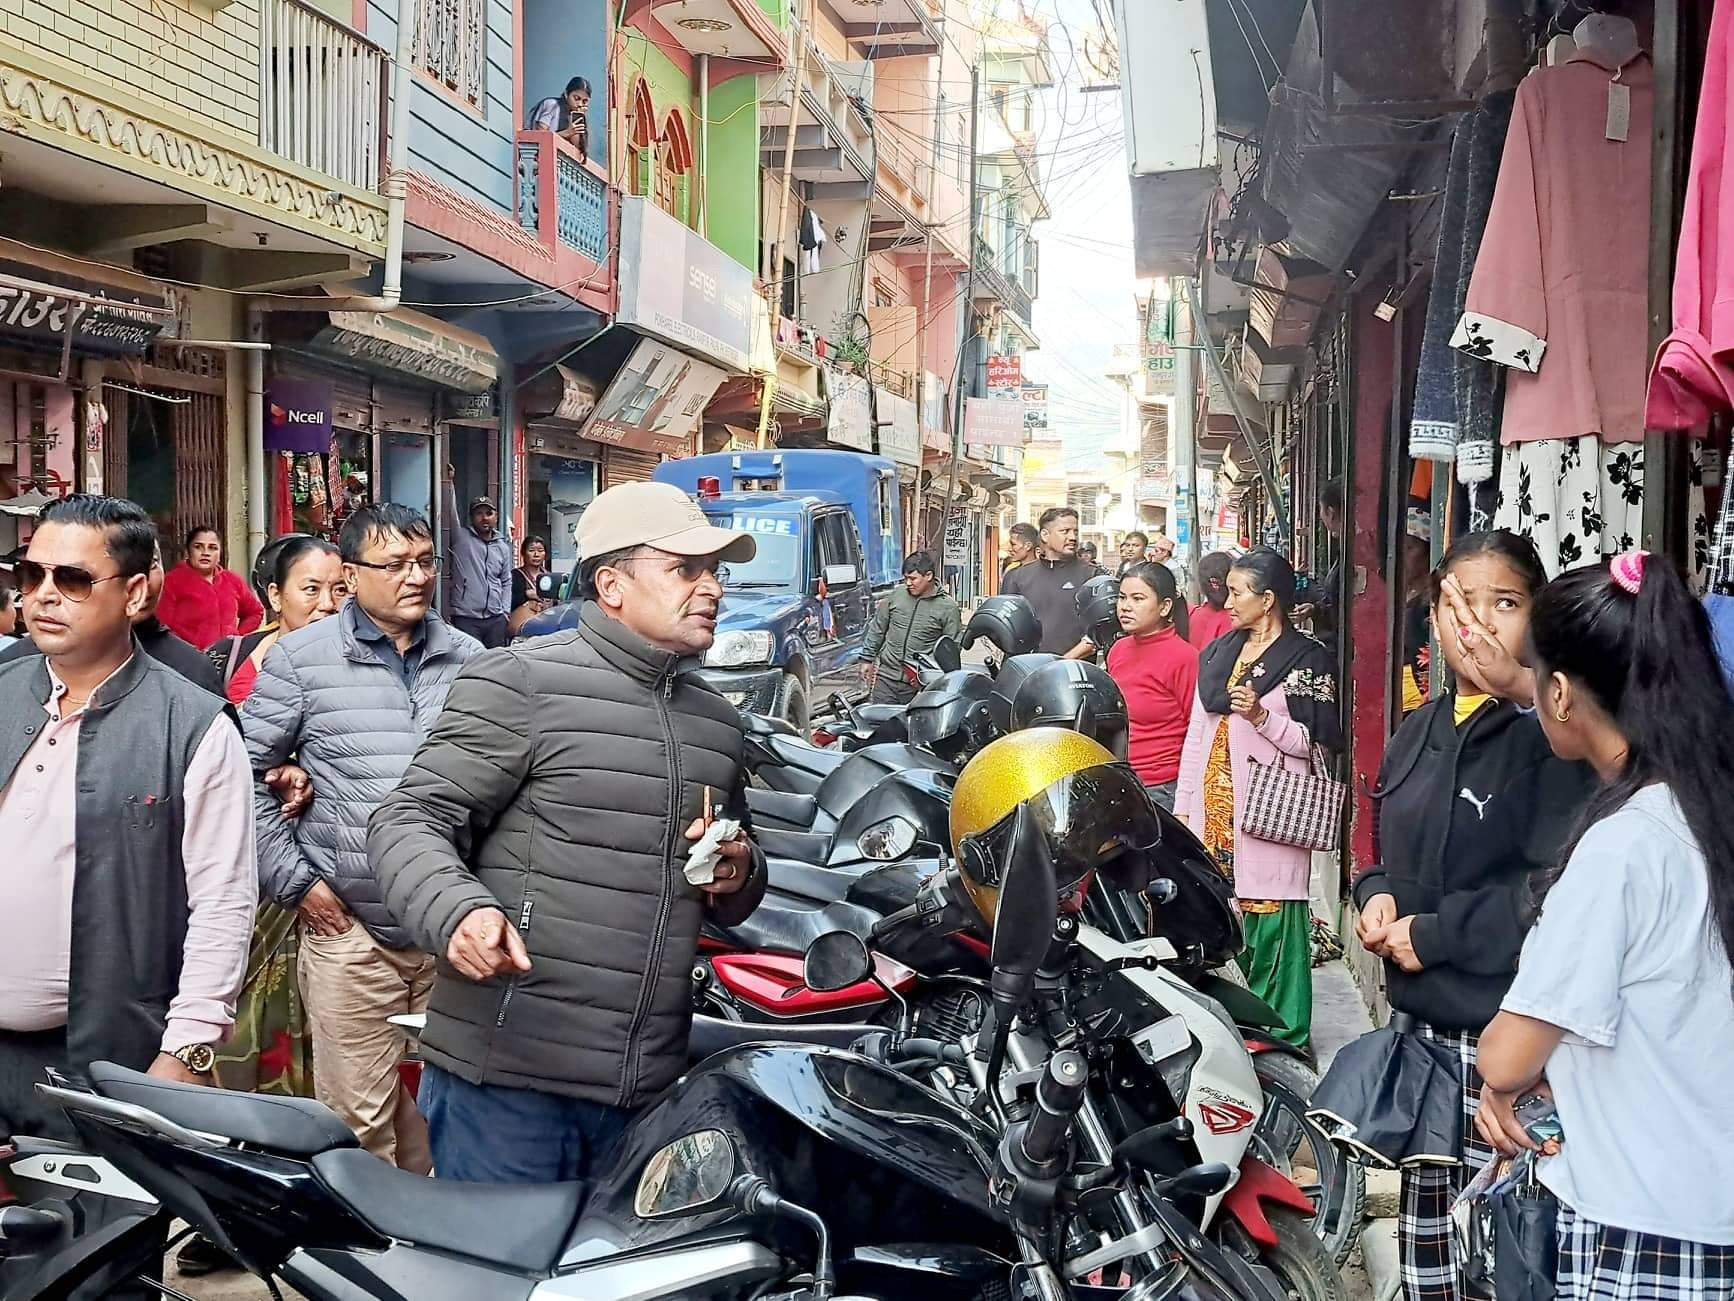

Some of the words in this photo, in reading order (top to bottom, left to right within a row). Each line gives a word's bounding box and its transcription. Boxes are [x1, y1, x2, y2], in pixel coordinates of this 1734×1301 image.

[1148, 357, 1174, 370] हाउ
[288, 410, 324, 424] Ncell
[713, 517, 792, 534] OLICE
